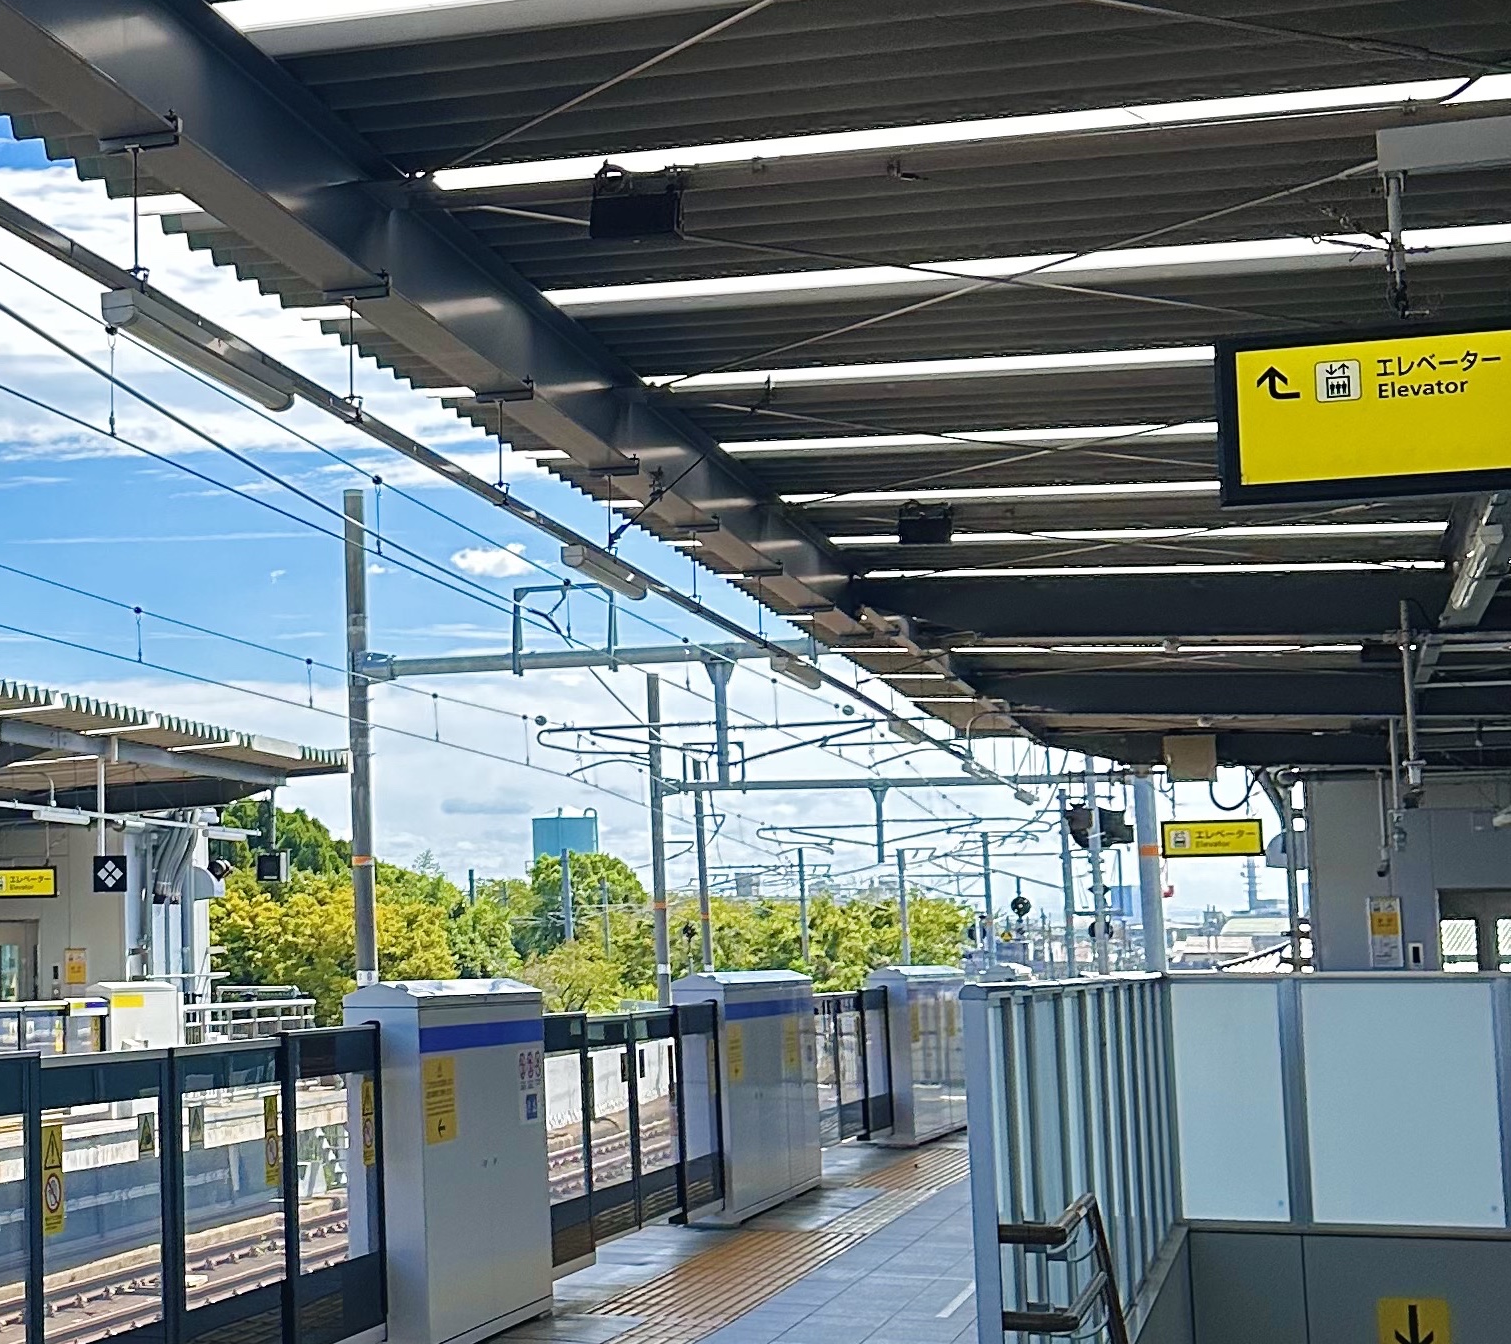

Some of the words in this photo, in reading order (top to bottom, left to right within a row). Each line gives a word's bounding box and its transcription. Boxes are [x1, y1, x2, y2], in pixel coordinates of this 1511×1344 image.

[1376, 350, 1502, 378] エレベーター
[1377, 379, 1469, 400] Elevator
